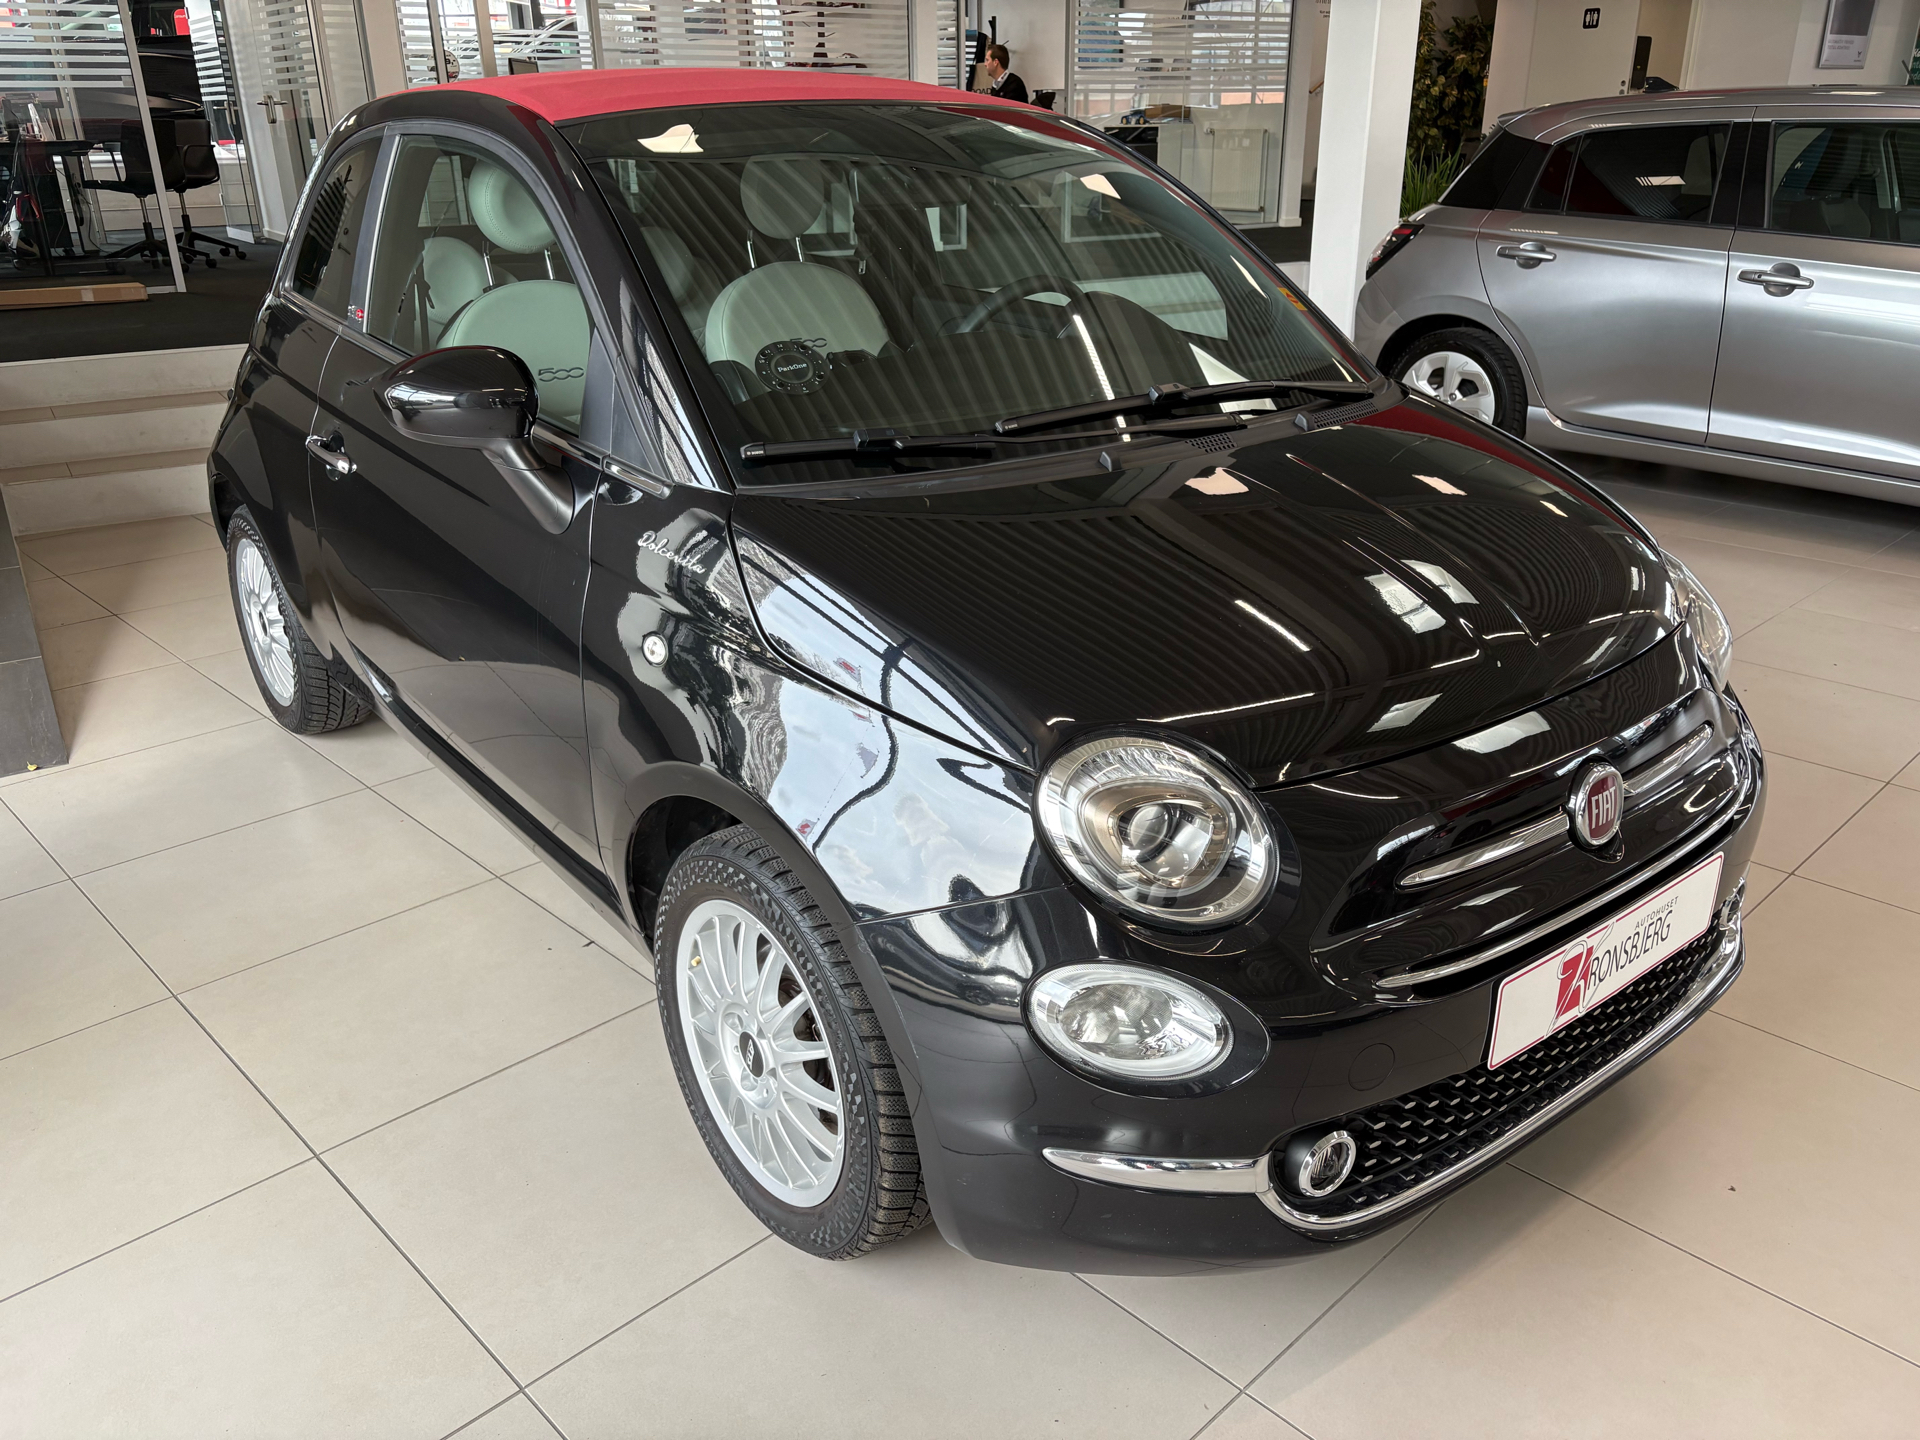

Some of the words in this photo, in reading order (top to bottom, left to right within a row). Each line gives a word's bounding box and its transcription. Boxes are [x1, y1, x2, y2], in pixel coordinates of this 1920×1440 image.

[538, 367, 584, 382] 500
[777, 363, 808, 373] ParkOne
[637, 530, 707, 574] Dolcevita
[1591, 786, 1616, 830] FIAT
[1634, 896, 1679, 931] AUTOHUSET
